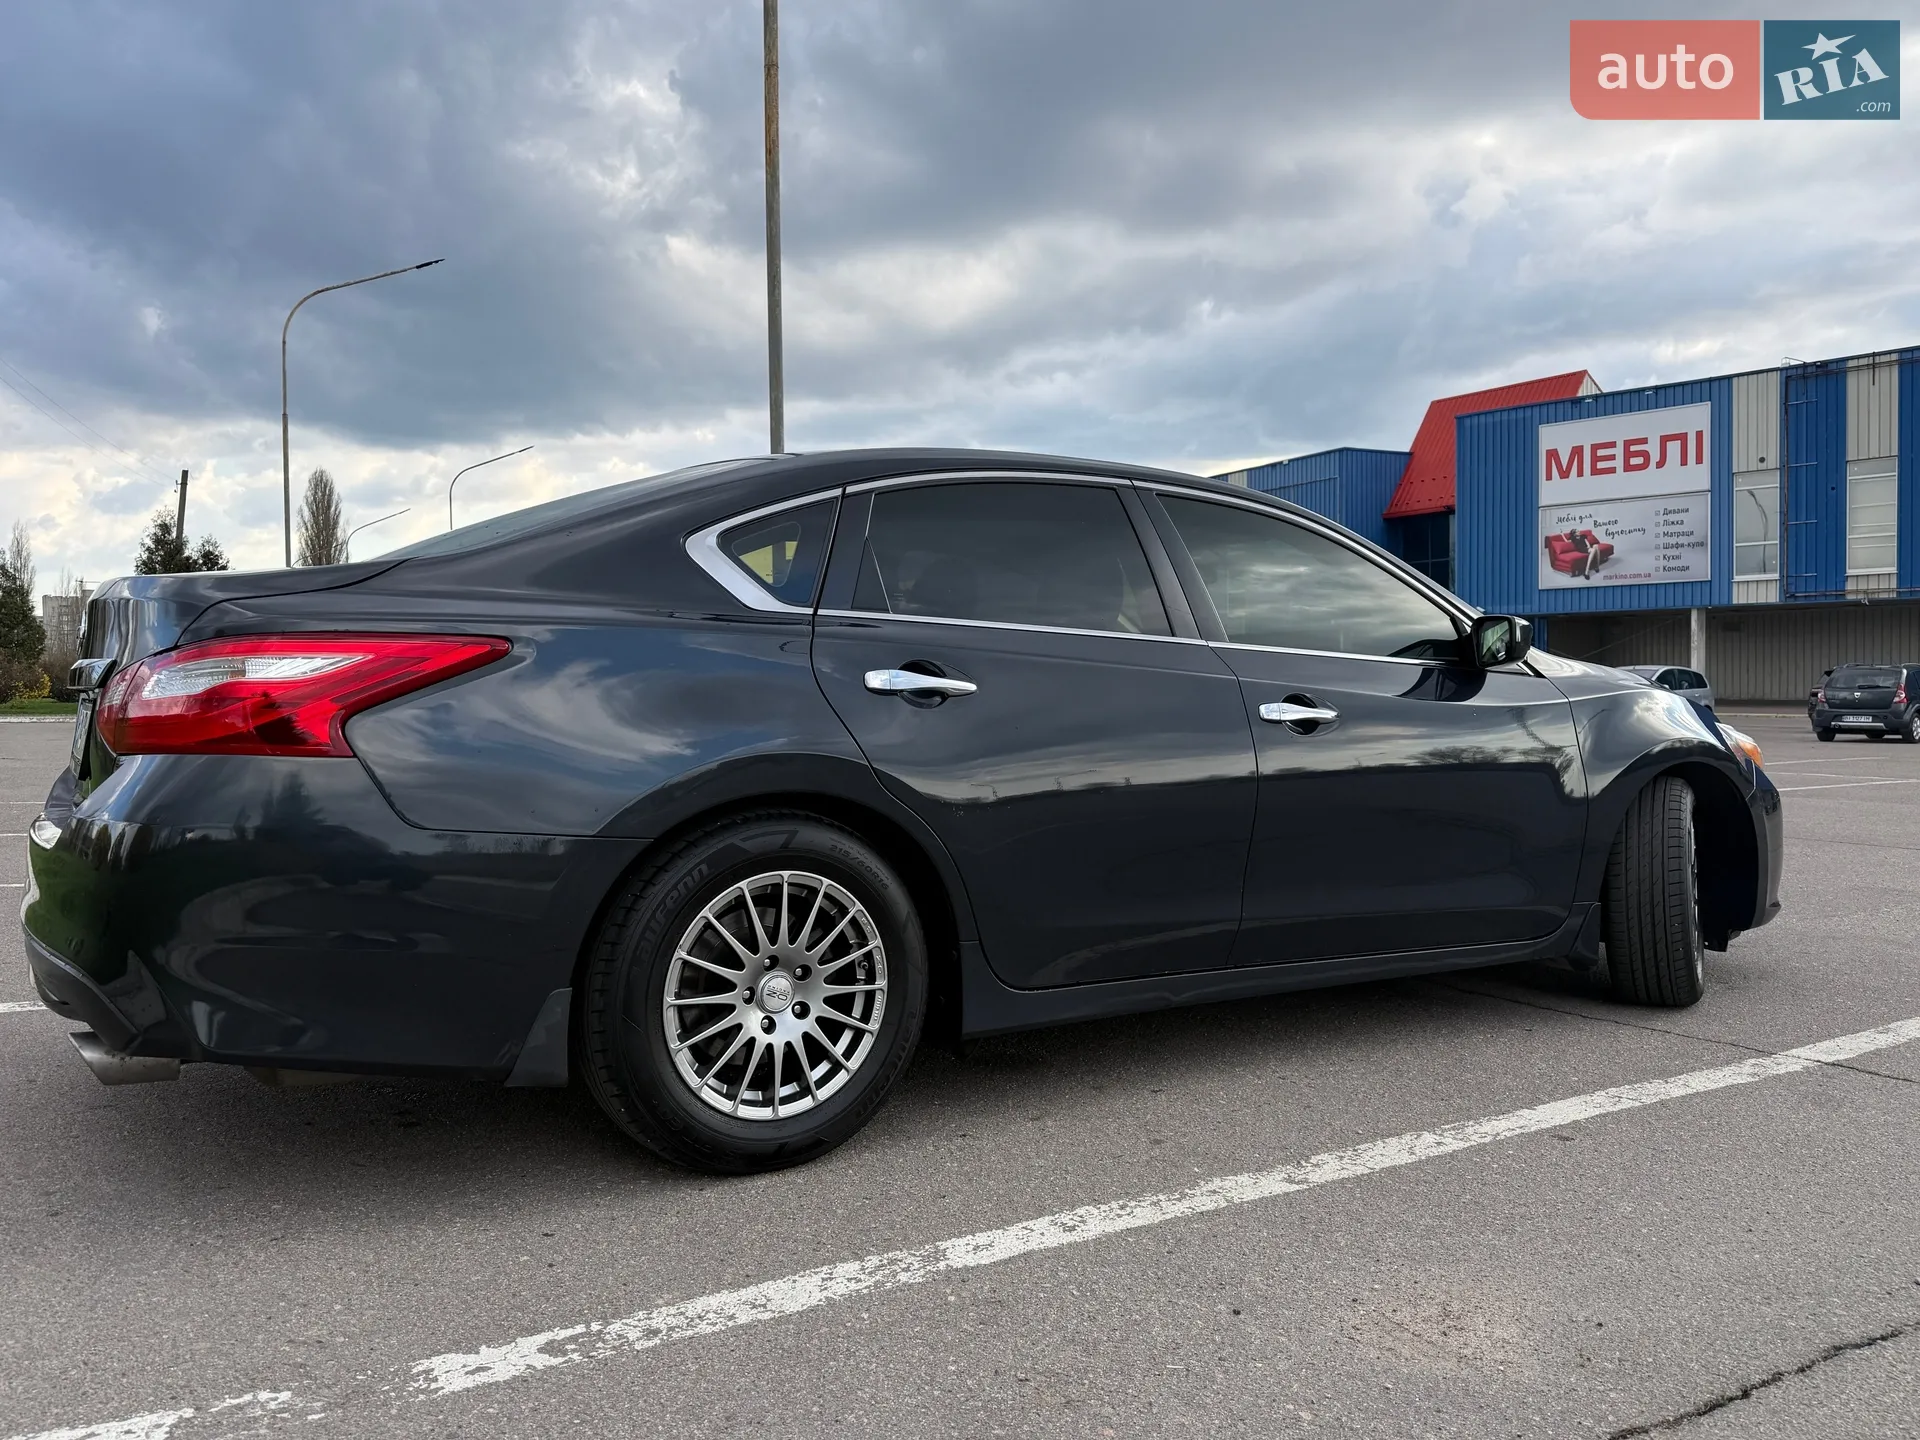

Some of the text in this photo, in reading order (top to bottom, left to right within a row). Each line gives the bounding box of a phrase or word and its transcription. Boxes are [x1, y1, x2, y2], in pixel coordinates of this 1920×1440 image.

[1545, 430, 1704, 481] МЕБЛІ
[1662, 507, 1690, 516] Дивани
[1662, 518, 1685, 527] Ліжка
[1662, 530, 1695, 539] Матраци
[1662, 552, 1682, 562] Кухні
[1662, 564, 1690, 573] Комоди
[1602, 572, 1652, 581] markino.com.ua
